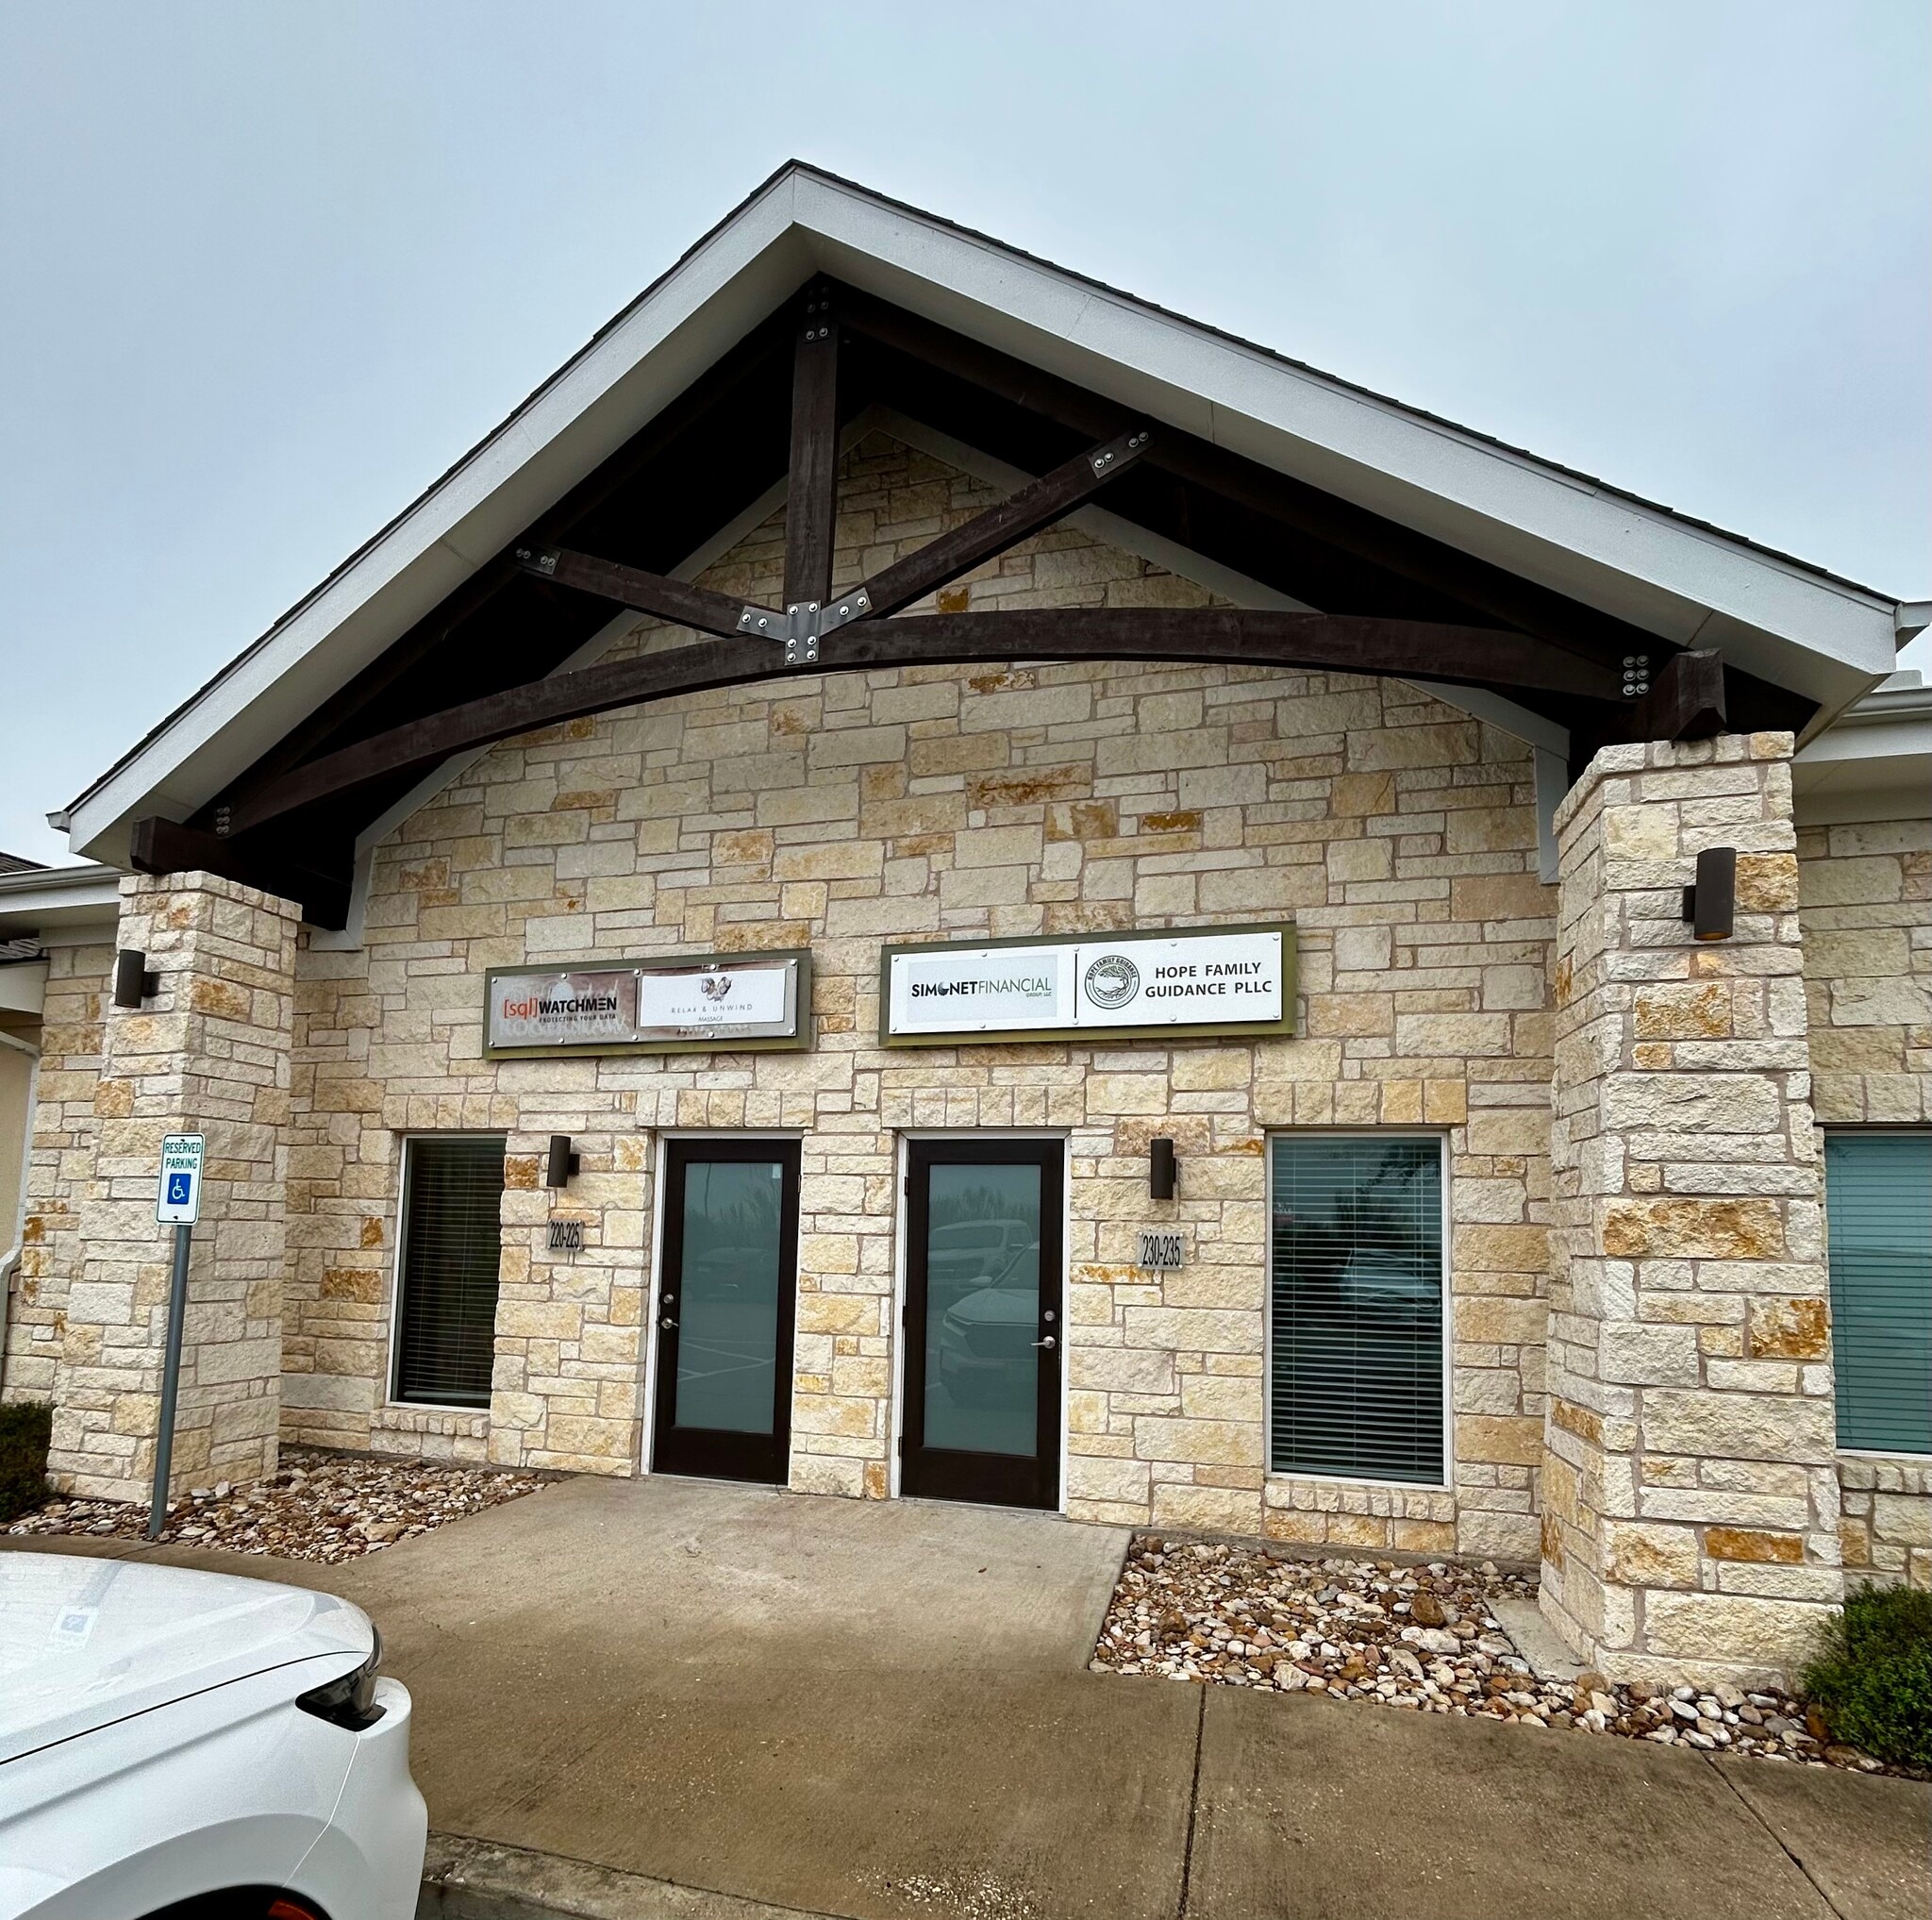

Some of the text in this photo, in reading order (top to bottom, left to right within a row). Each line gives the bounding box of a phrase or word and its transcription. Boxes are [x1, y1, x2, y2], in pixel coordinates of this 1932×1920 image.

[1155, 961, 1262, 979] HOPE FAMILY
[1145, 980, 1273, 998] GUIDANCE PLLC
[712, 1003, 754, 1012] UNWIND
[539, 1015, 578, 1024] PROTECTING
[164, 1142, 202, 1154] RESERVED
[165, 1157, 198, 1170] PARKING
[550, 1222, 580, 1248] 220-225
[1142, 1234, 1181, 1266] 230-235
